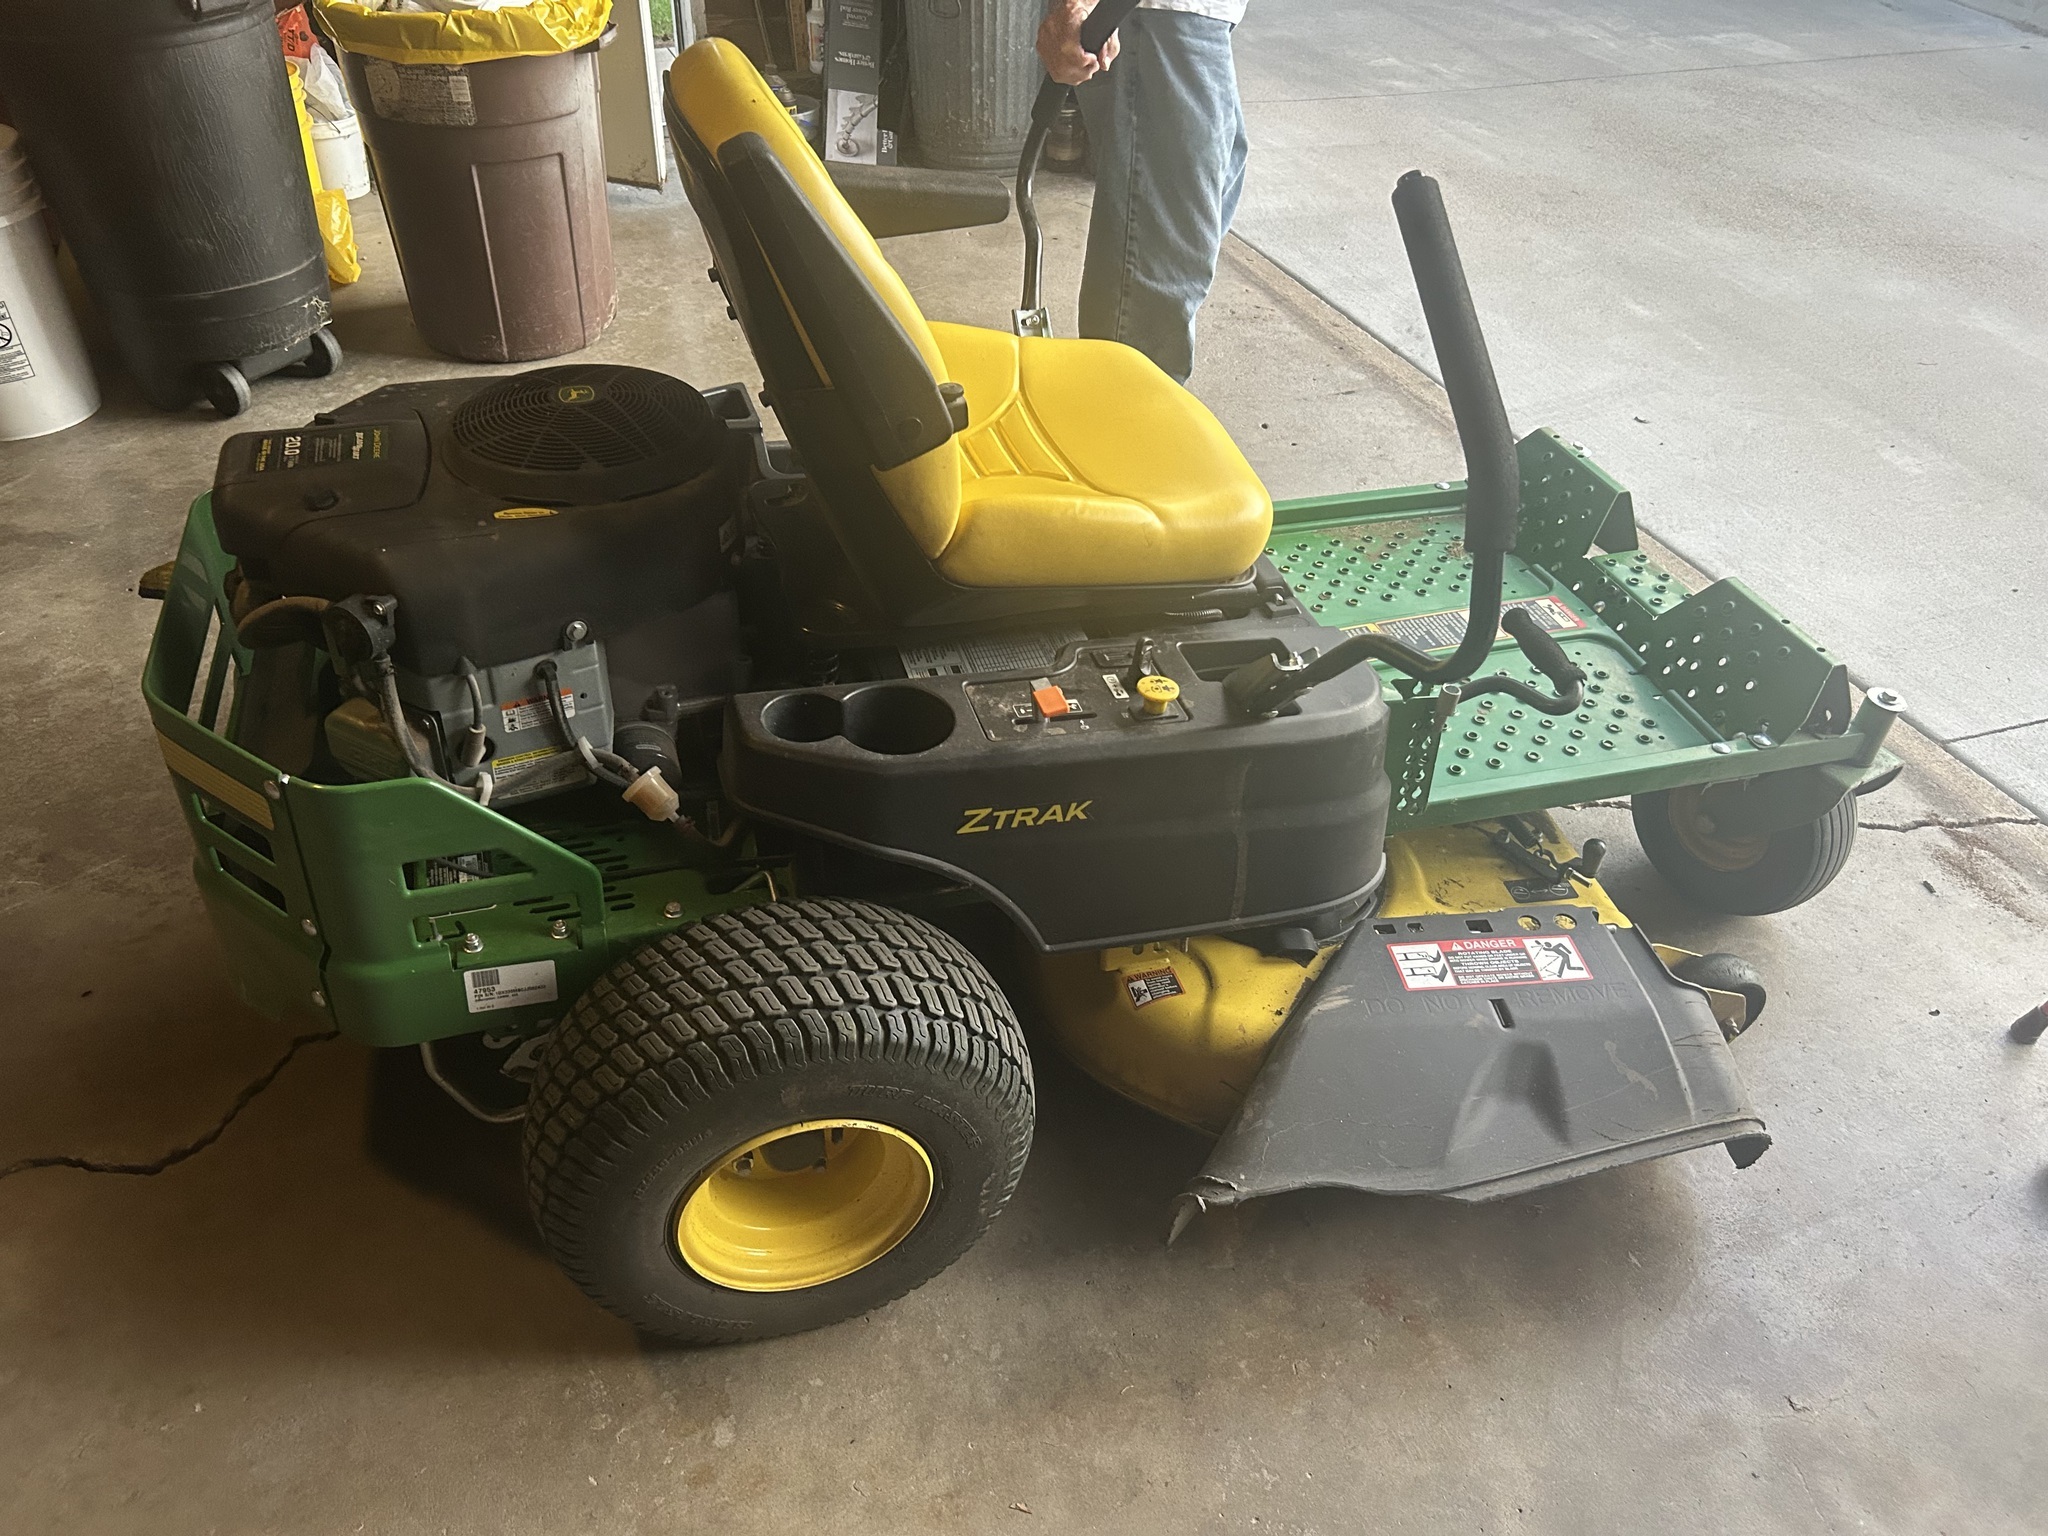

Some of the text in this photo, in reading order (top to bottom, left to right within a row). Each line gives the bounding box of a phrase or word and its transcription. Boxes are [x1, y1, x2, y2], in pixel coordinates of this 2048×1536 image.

[840, 5, 851, 13] Rod
[835, 57, 855, 65] Homes
[284, 436, 301, 455] 20.0
[956, 800, 1093, 834] ZTRAK
[1463, 940, 1516, 949] DANGER
[1134, 968, 1172, 980] WARNING
[1363, 983, 1634, 1016] DO NOT REMOVE
